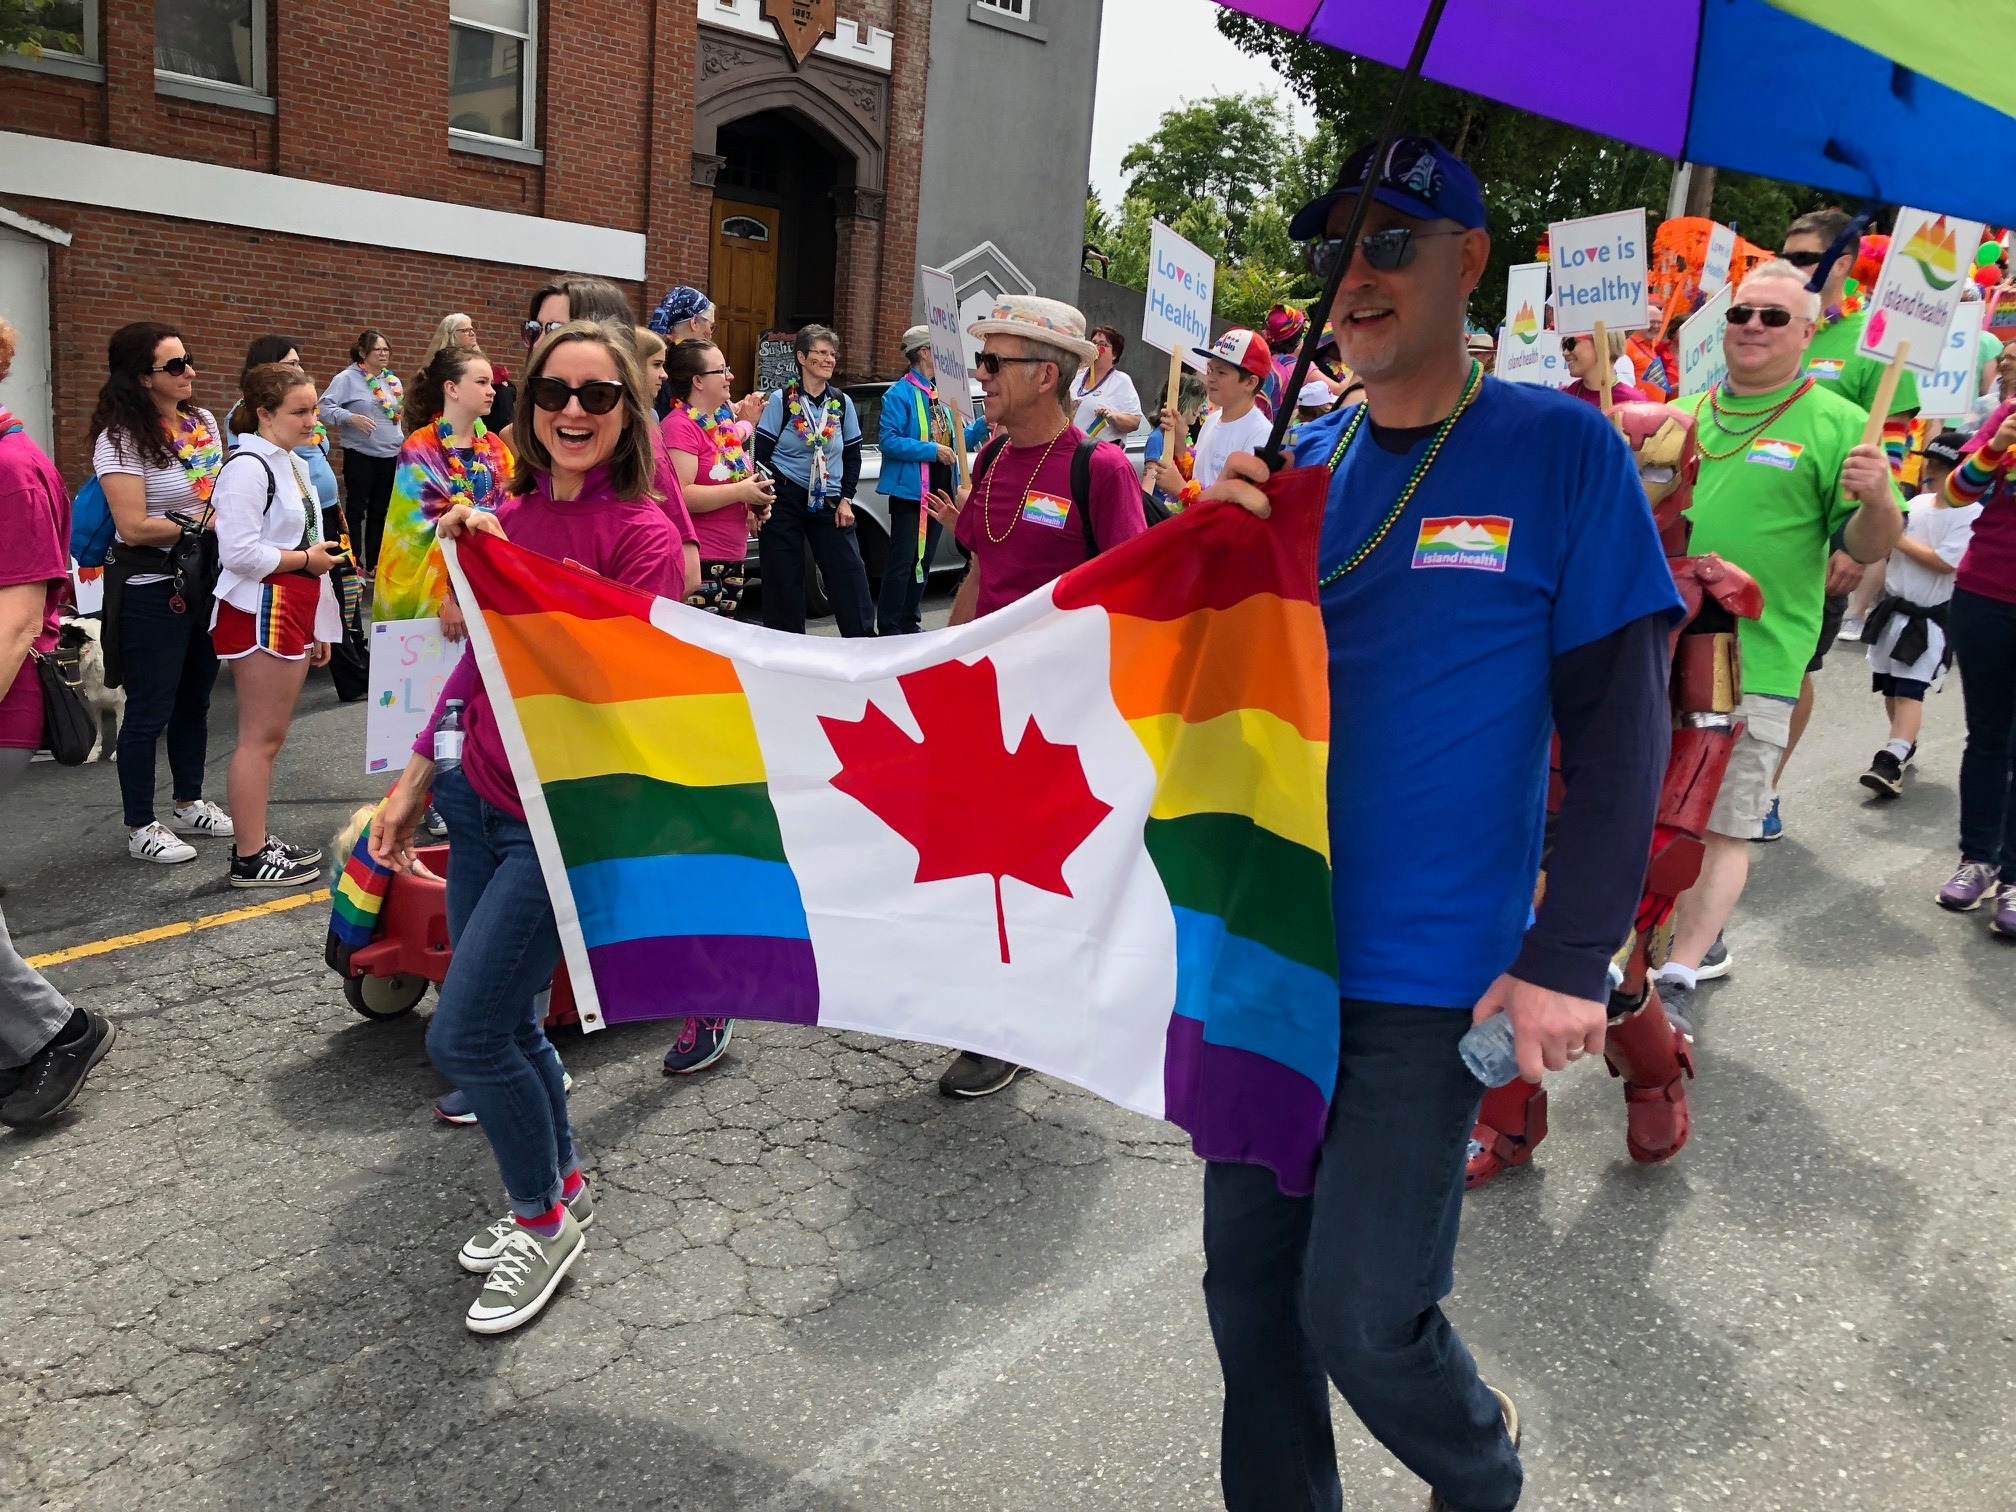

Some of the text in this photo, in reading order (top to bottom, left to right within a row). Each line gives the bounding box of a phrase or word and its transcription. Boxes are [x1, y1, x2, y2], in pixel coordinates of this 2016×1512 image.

[1560, 235, 1635, 269] Love is
[1157, 249, 1207, 300] Love is
[1558, 274, 1642, 307] Healthy
[928, 297, 956, 334] Love is
[1151, 288, 1207, 347] Healthy
[1882, 281, 1949, 328] island health
[759, 341, 793, 356] Sushi
[1685, 333, 1713, 374] Love
[1950, 331, 1966, 349] s
[933, 343, 966, 392] Healthy
[1026, 511, 1061, 527] island health
[1423, 552, 1497, 566] island health
